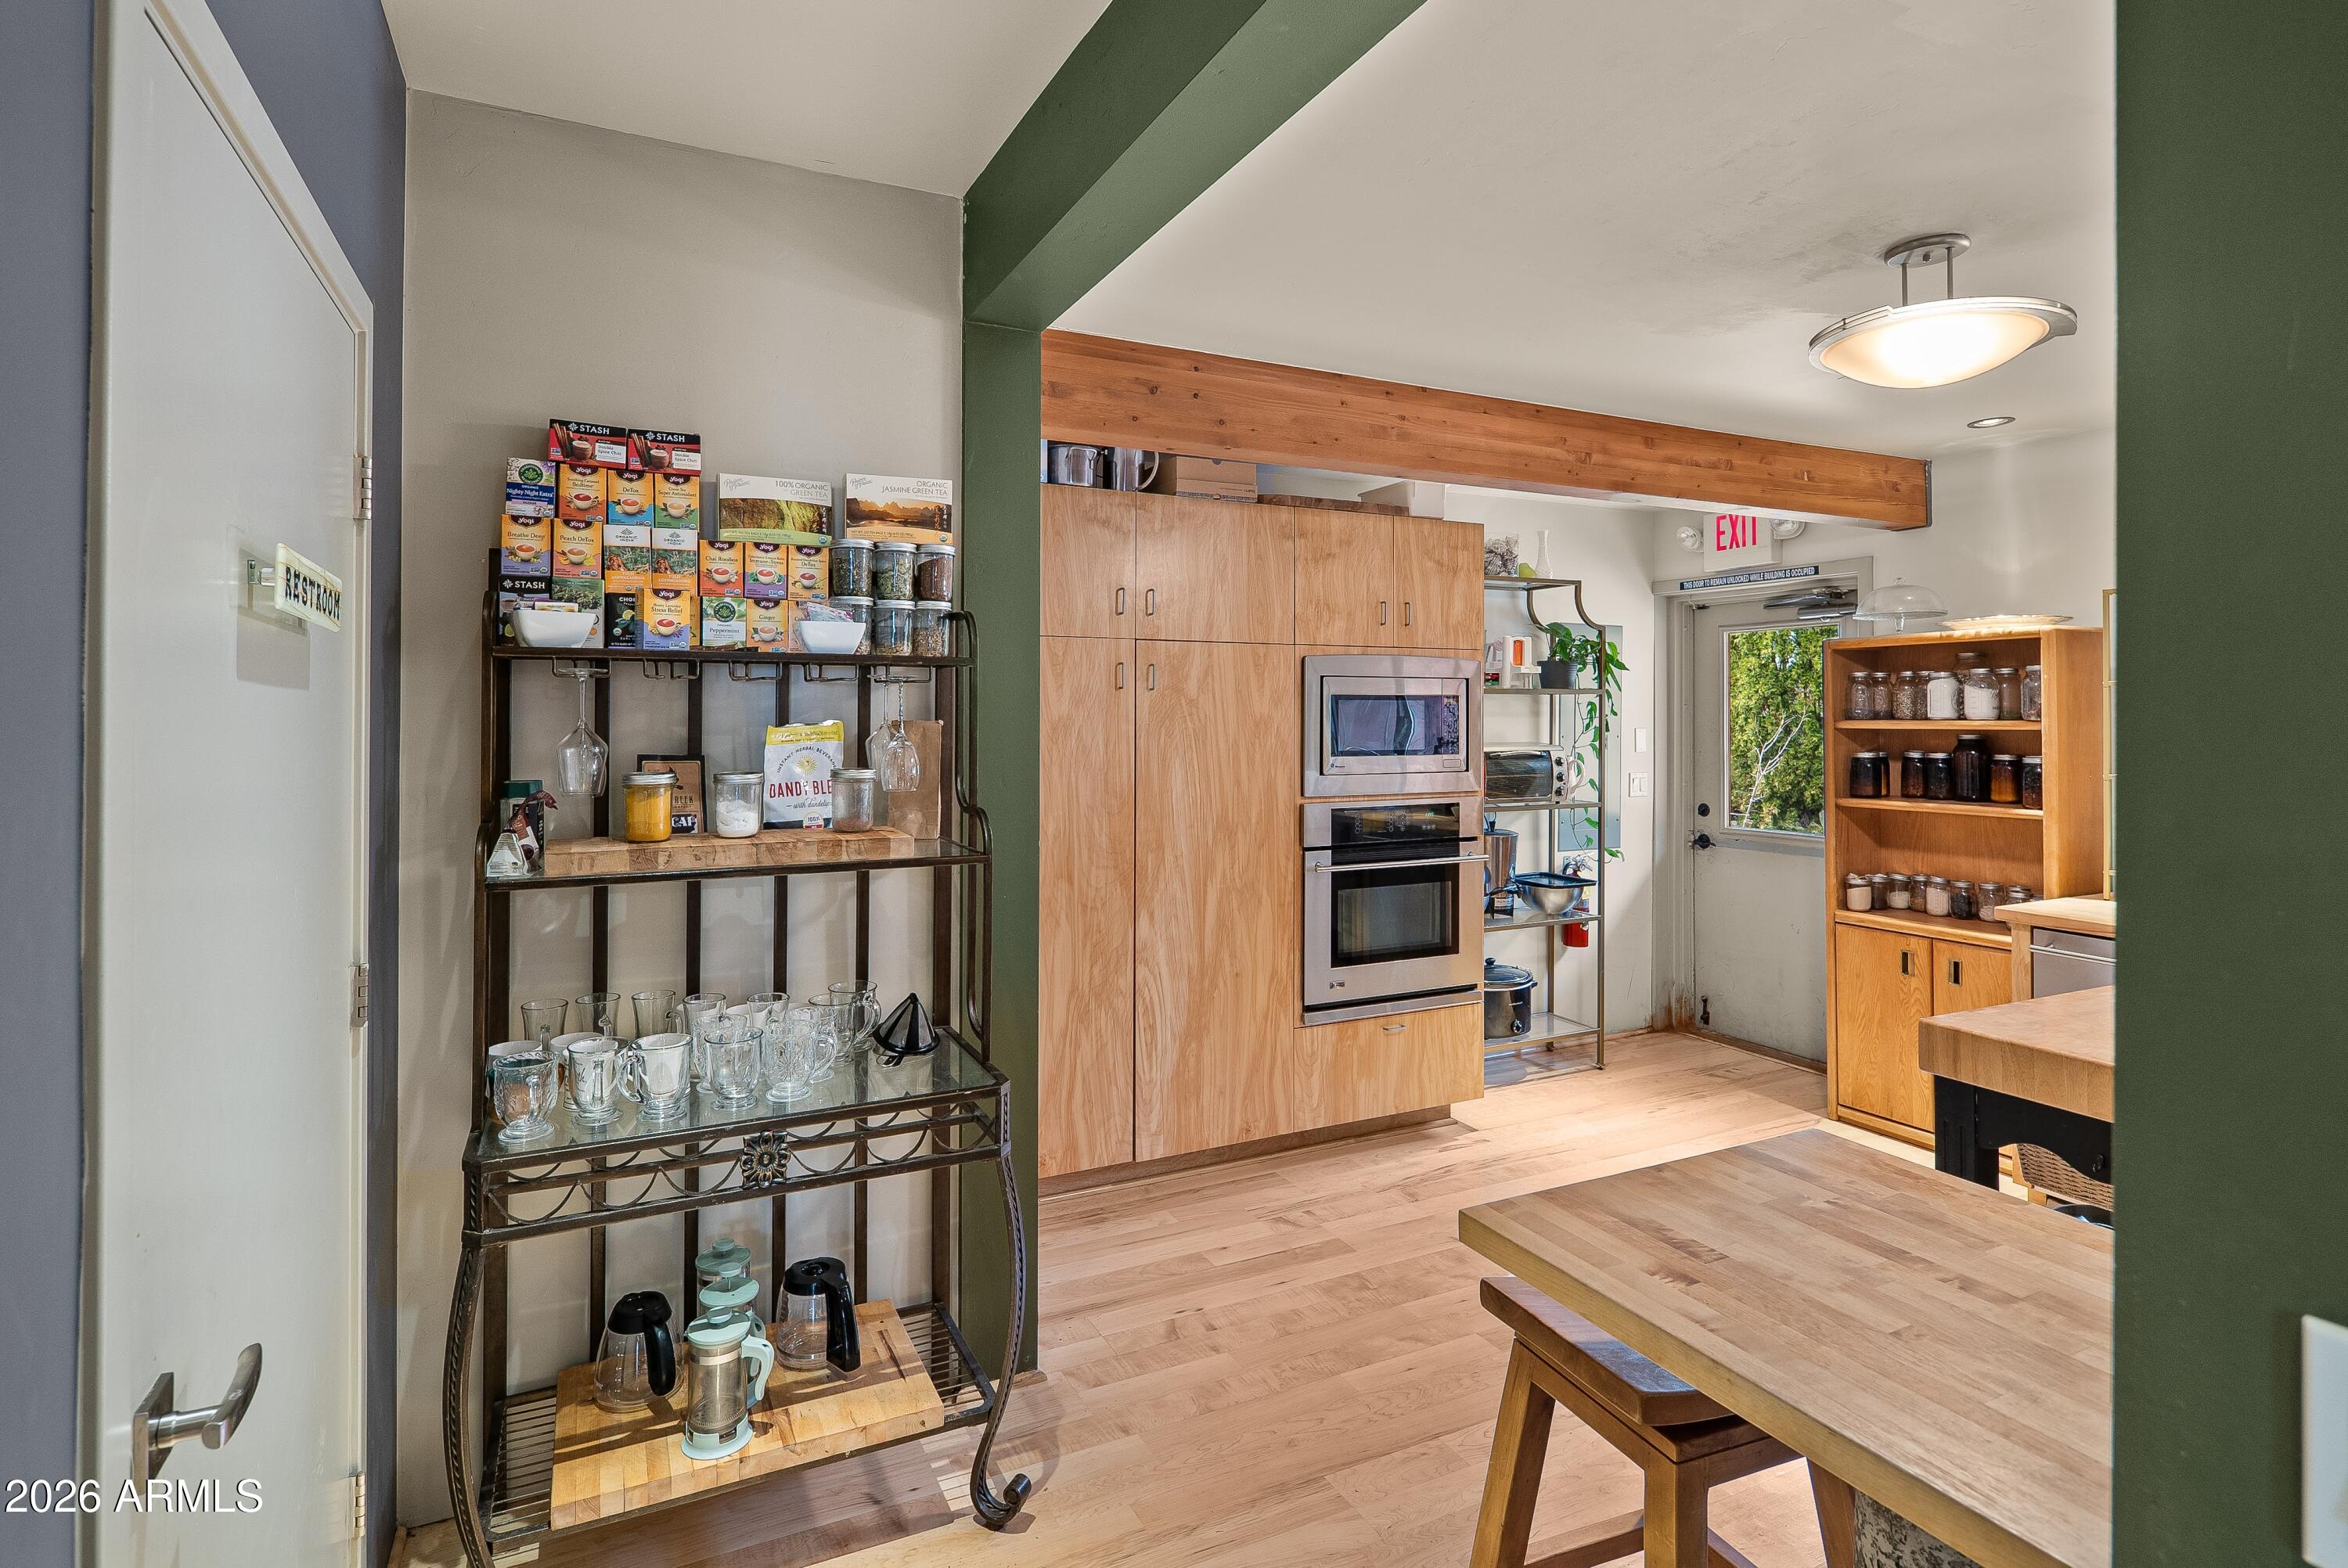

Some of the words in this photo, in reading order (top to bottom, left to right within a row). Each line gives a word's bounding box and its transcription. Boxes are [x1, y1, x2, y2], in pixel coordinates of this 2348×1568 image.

[579, 424, 610, 435] STASH
[656, 433, 686, 443] STASH
[775, 480, 794, 489] 100%
[794, 482, 828, 492] ORGANIC
[881, 485, 910, 494] JASMINE
[912, 487, 933, 495] GREEN
[917, 480, 948, 489] ORGANIC
[790, 488, 814, 498] GREEN
[815, 490, 828, 499] TEA
[1716, 513, 1757, 552] EXIT
[1683, 581, 1693, 590] THIS
[1727, 575, 1749, 584] UNLOCKED
[1749, 573, 1764, 582] WHILE
[1764, 570, 1785, 580] BUILDING
[1791, 566, 1815, 577] OCCUPIED
[514, 581, 546, 589] STASH
[285, 566, 340, 620] RESTROOM
[776, 752, 794, 774] INSTANT
[812, 779, 832, 795] BLE
[674, 795, 693, 804] REEK
[793, 800, 806, 809] with
[806, 797, 832, 807] dandelio
